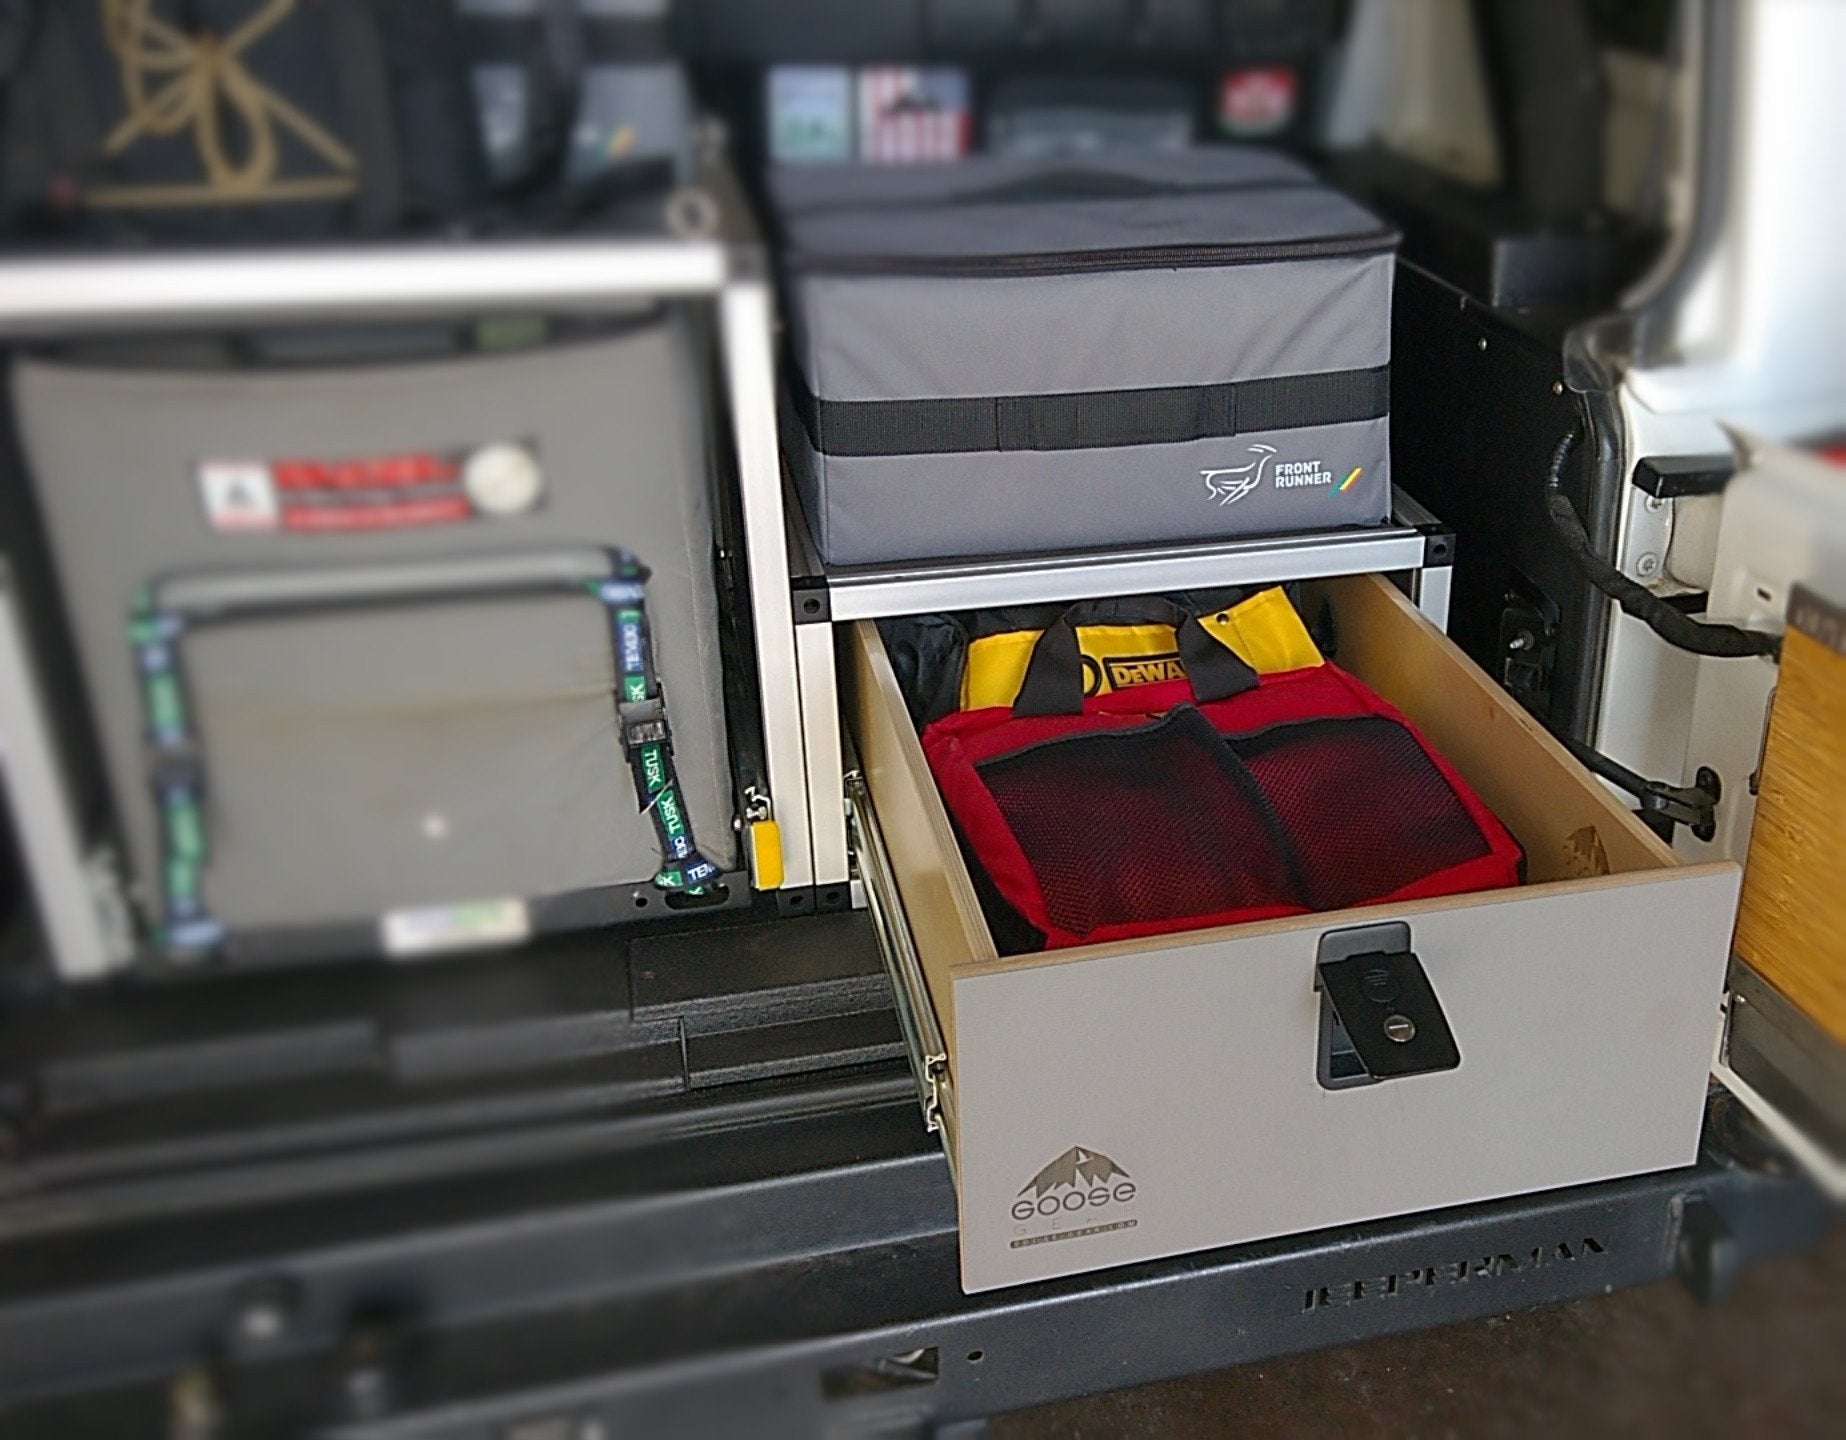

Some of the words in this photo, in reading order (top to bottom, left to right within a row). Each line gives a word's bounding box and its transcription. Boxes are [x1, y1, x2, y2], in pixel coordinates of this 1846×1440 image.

[1275, 460, 1321, 477] FRONT
[1275, 471, 1332, 489] RUNNER
[1110, 661, 1188, 686] DEWA
[644, 749, 662, 788] TUSK
[660, 797, 682, 834] TUSK
